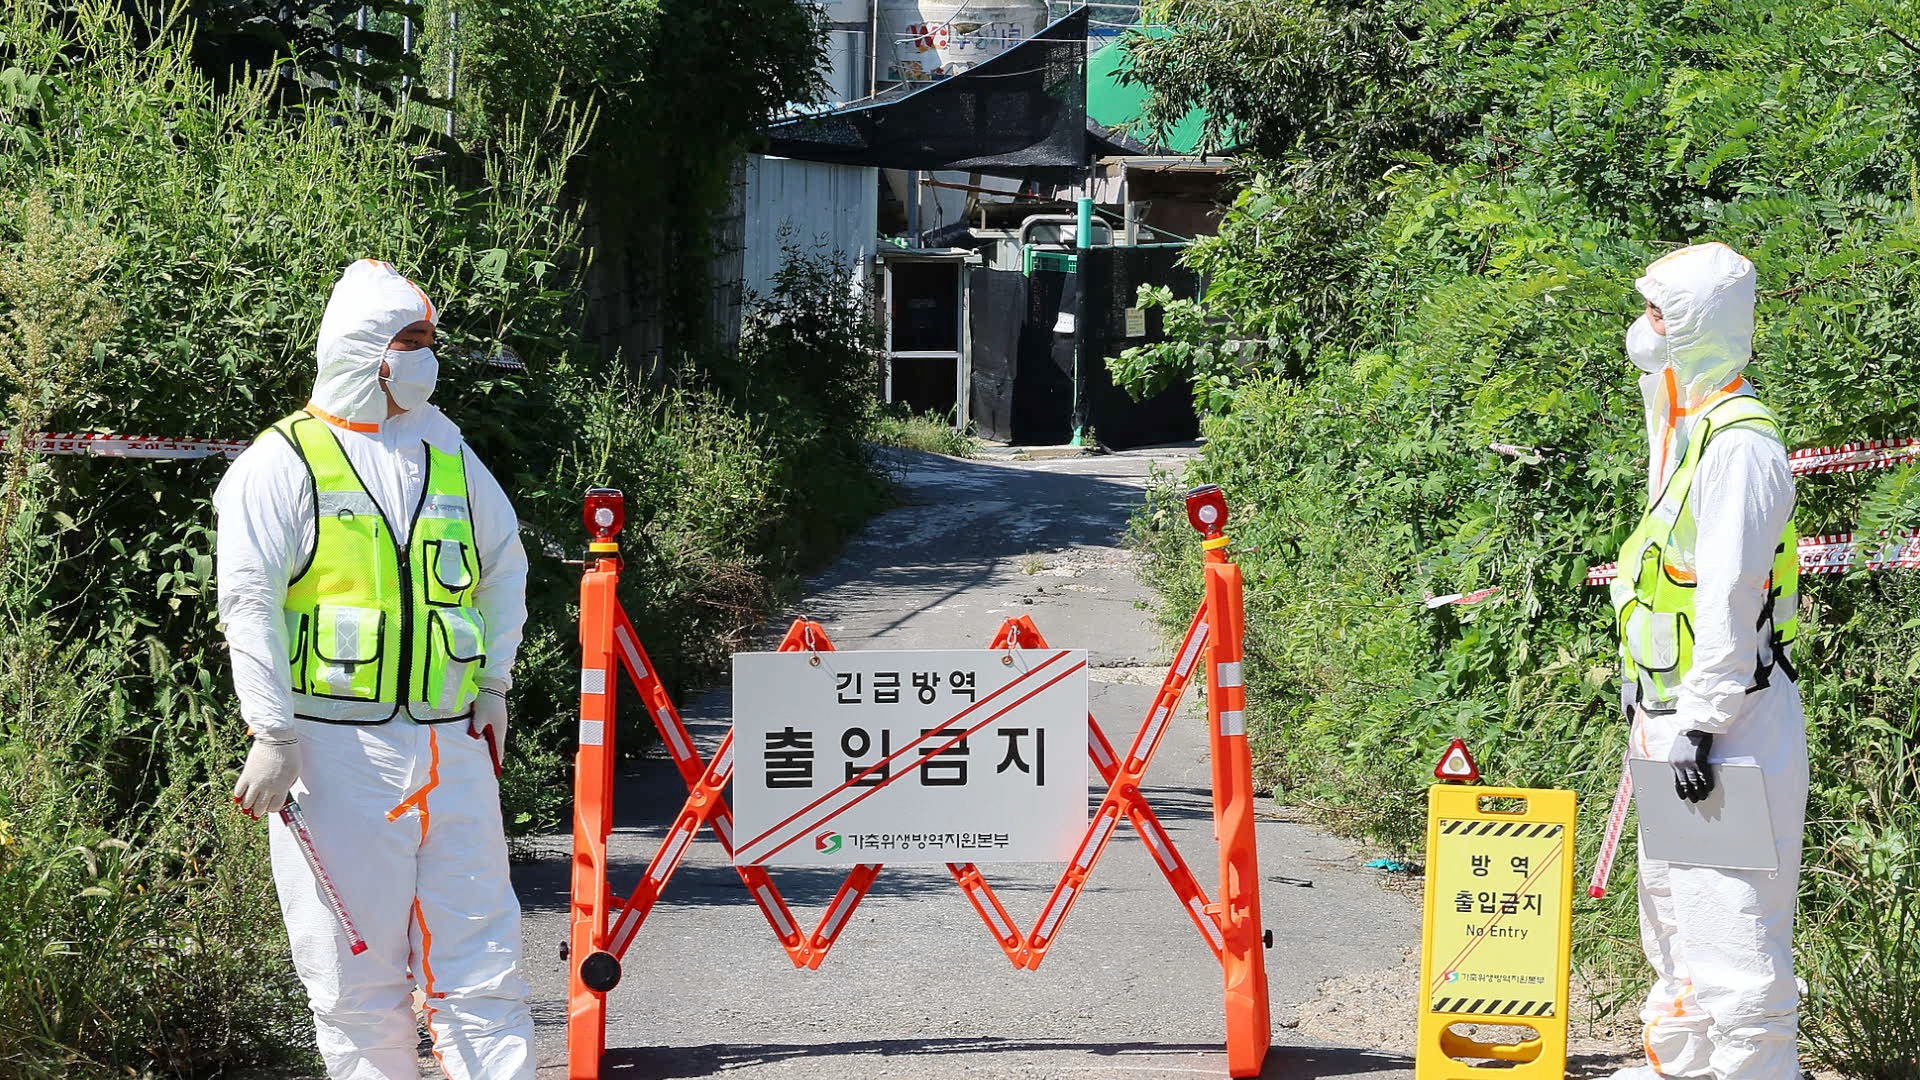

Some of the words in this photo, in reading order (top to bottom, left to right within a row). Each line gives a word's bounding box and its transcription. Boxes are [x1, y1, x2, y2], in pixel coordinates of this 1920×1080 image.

[763, 726, 1045, 789] 출입금지
[848, 832, 1010, 850] 가축위생방역지원본부
[1454, 890, 1543, 916] 출입금지
[1466, 925, 1484, 937] No
[1490, 924, 1529, 940] Entry
[1461, 973, 1545, 985] 가축위생방역지원본부
